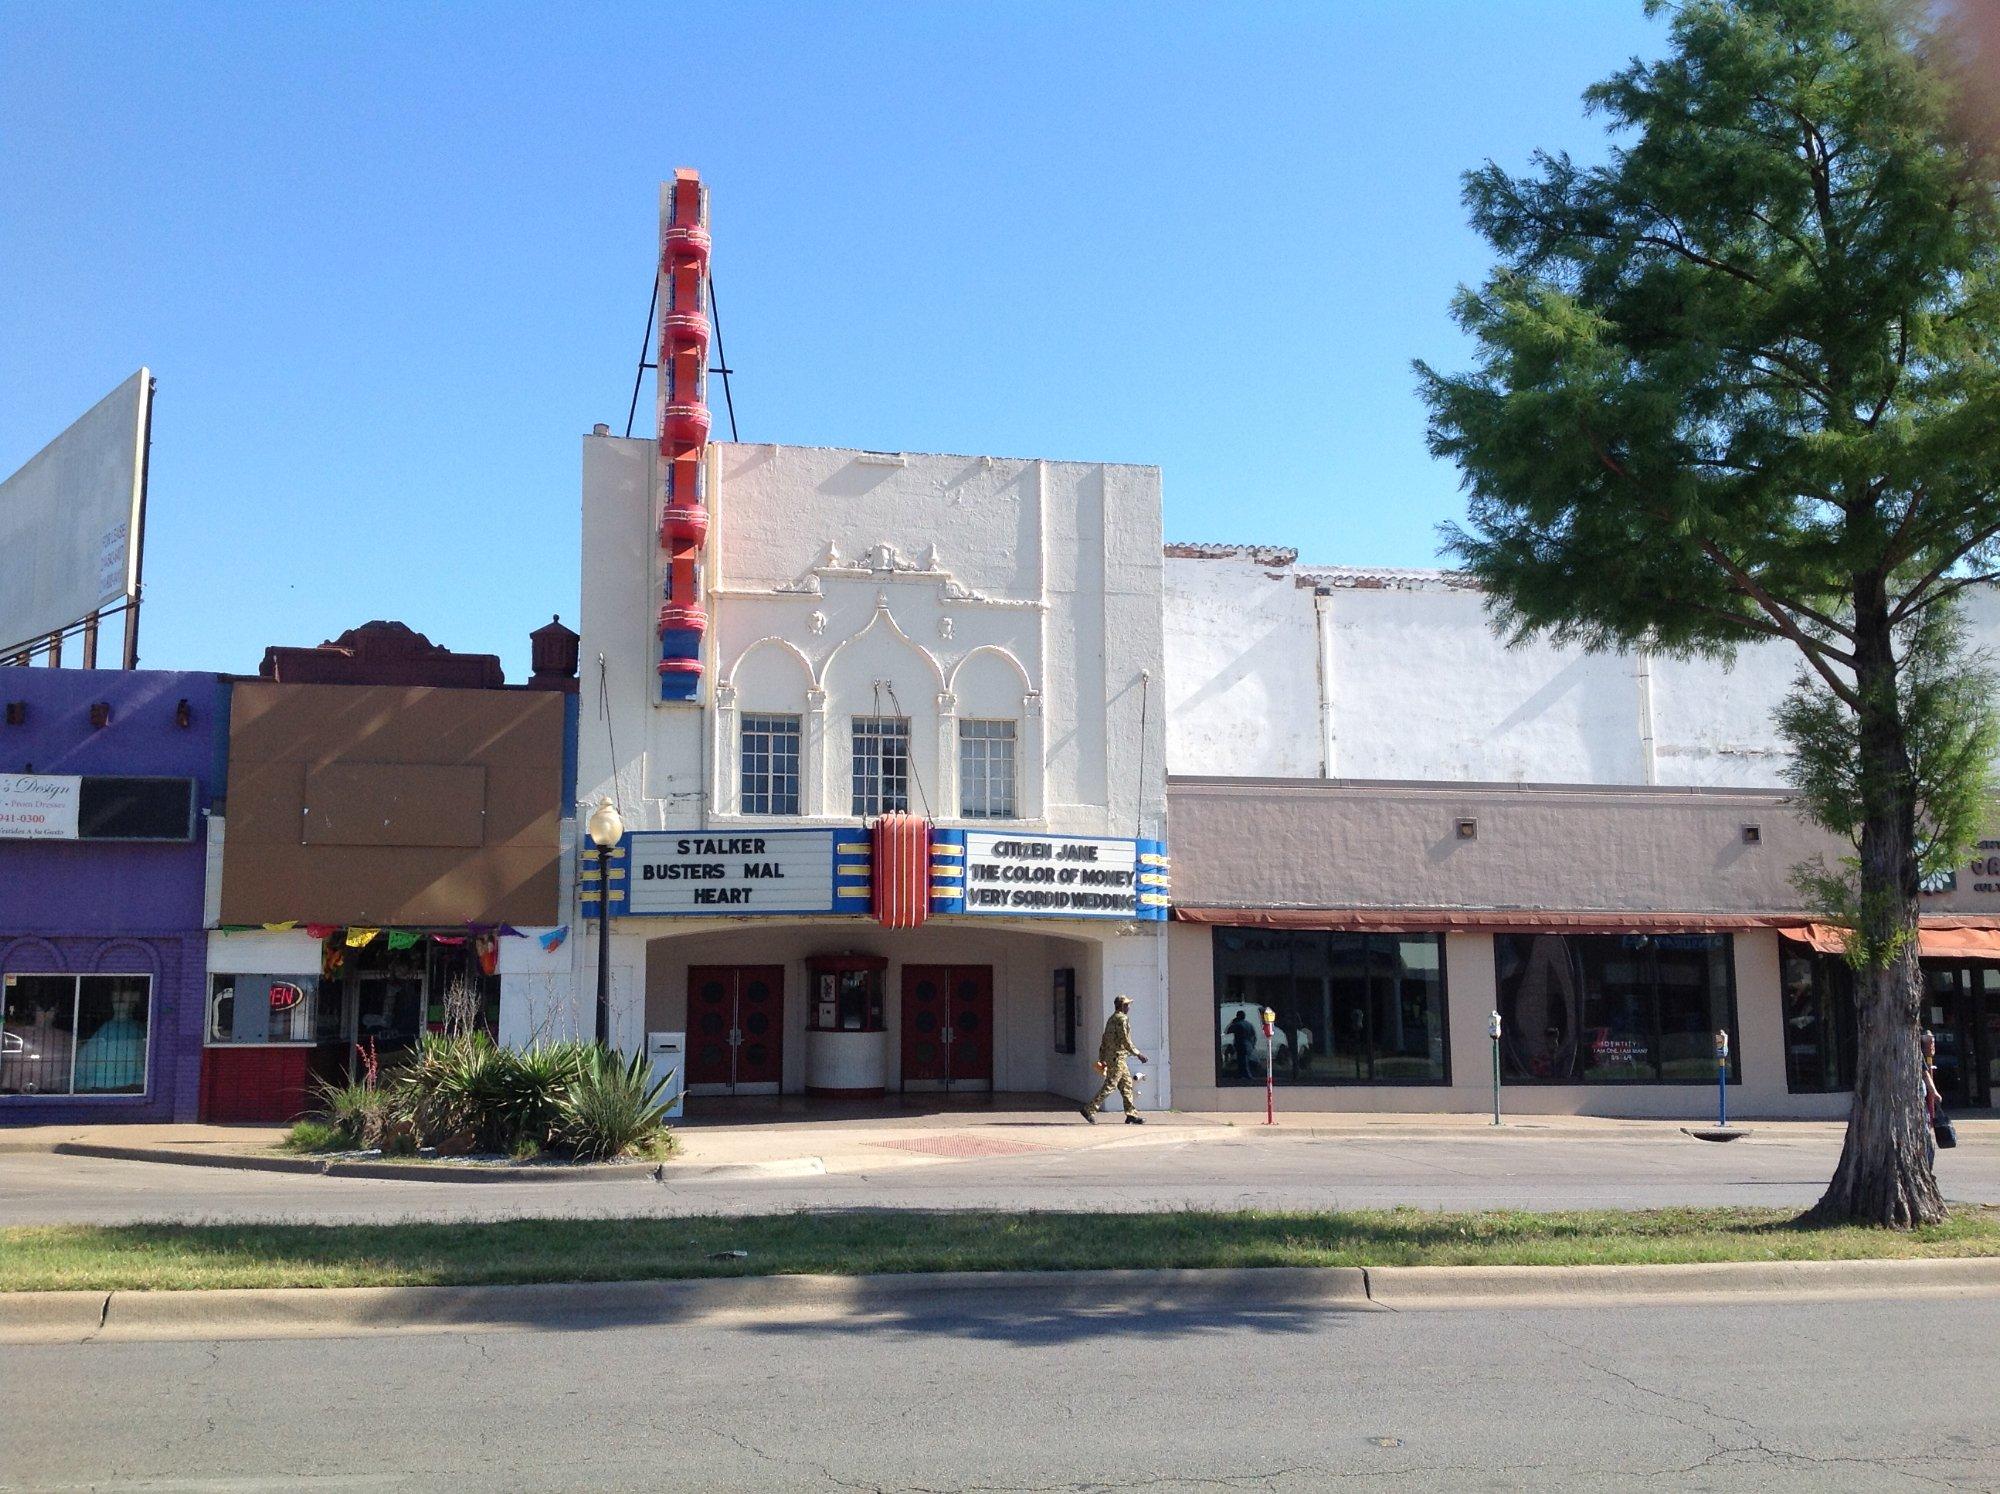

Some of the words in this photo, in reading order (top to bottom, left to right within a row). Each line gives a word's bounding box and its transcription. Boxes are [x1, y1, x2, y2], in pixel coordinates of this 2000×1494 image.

[13, 776, 70, 800] Design
[677, 838, 766, 855] STALKER
[991, 840, 1053, 861] CITIZEN
[1055, 844, 1099, 862] JANE
[643, 864, 725, 880] BUSTERS
[743, 863, 785, 879] MAL
[970, 863, 1001, 881] THE
[1001, 866, 1056, 884] COLOR
[1057, 868, 1080, 885] OF
[1080, 869, 1135, 887] MONEY
[693, 888, 753, 904] HEART
[968, 888, 1012, 907] VERY
[1011, 889, 1071, 909] SORDID
[1071, 892, 1137, 911] WEDDING
